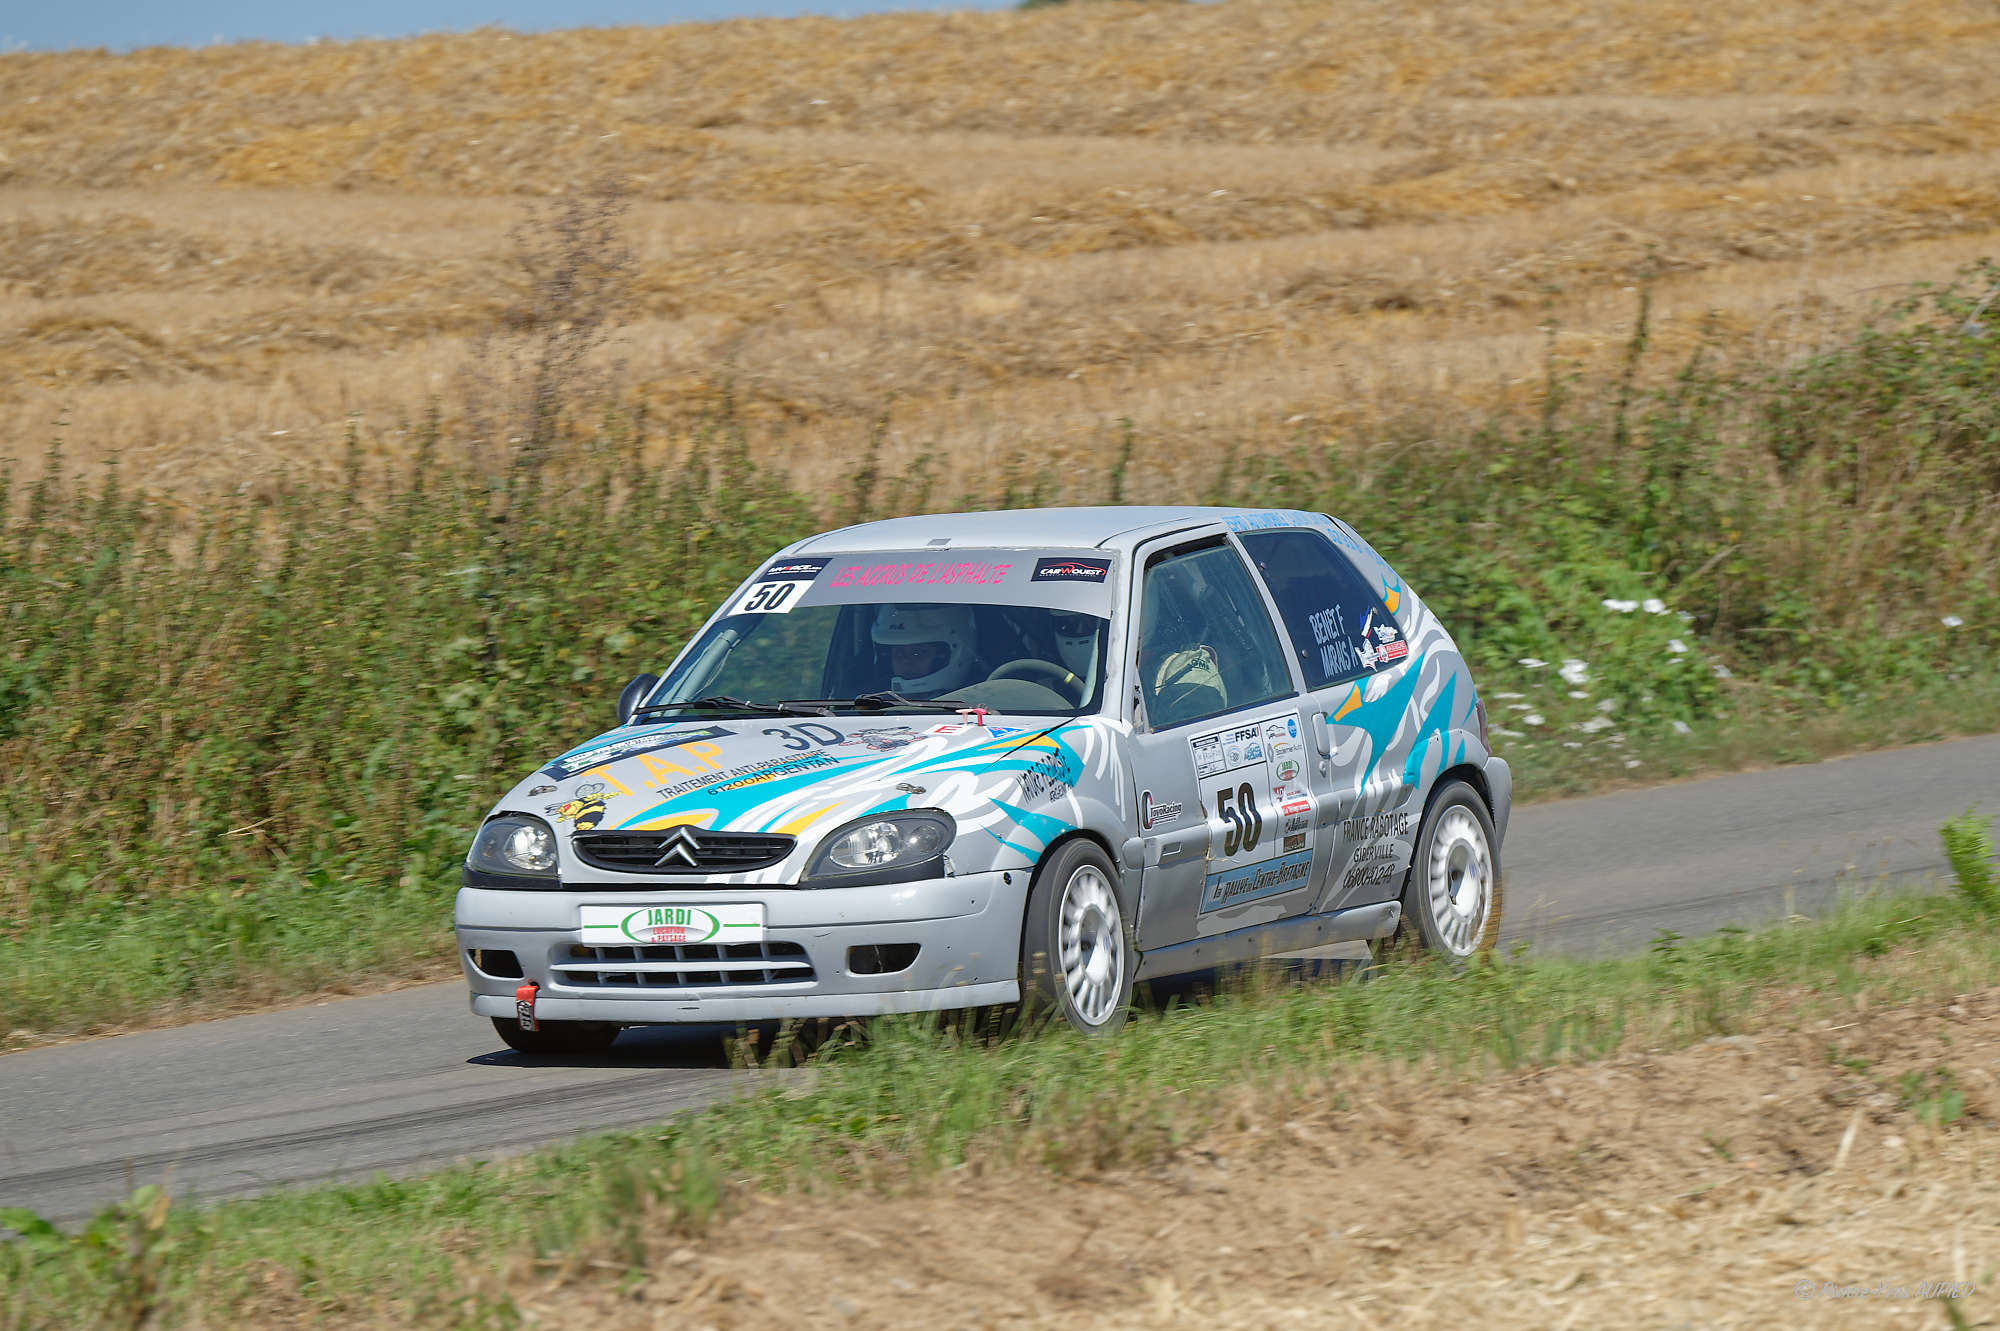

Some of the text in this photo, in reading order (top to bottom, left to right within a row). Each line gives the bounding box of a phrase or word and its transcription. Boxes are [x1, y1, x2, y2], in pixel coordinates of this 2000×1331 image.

[828, 565, 862, 589] LES
[853, 563, 912, 587] ACCROS
[906, 563, 936, 585] DE
[927, 561, 1014, 585] L'ASPHALTE
[743, 582, 796, 612] 50
[1334, 603, 1346, 636] F
[1320, 640, 1352, 679] MARAIS
[1347, 636, 1359, 668] A
[763, 721, 848, 751] 3D
[933, 725, 962, 734] E
[1234, 727, 1259, 742] FFSA
[656, 771, 732, 800] TRAITEMENT
[1216, 782, 1263, 857] 50
[1353, 843, 1395, 863] GIBERVILLE
[647, 908, 692, 926] JARDI
